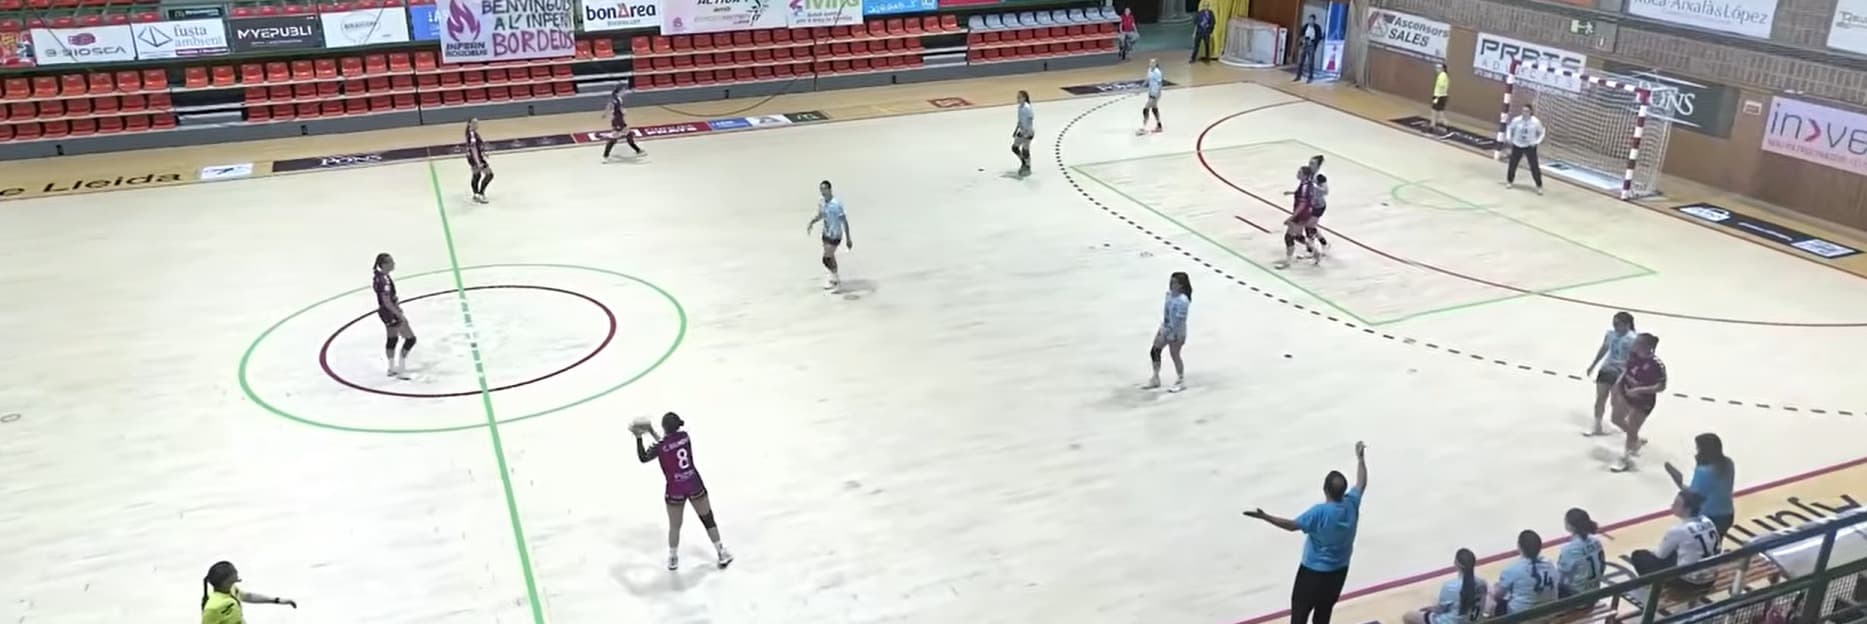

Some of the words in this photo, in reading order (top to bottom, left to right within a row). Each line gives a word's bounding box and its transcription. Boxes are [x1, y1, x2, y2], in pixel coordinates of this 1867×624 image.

[174, 24, 207, 37] fusta
[237, 25, 312, 39] MYEPUBLI
[494, 17, 506, 31] A
[1394, 17, 1449, 38] Ascensors
[1388, 28, 1430, 47] SALES
[676, 447, 690, 470] 8
